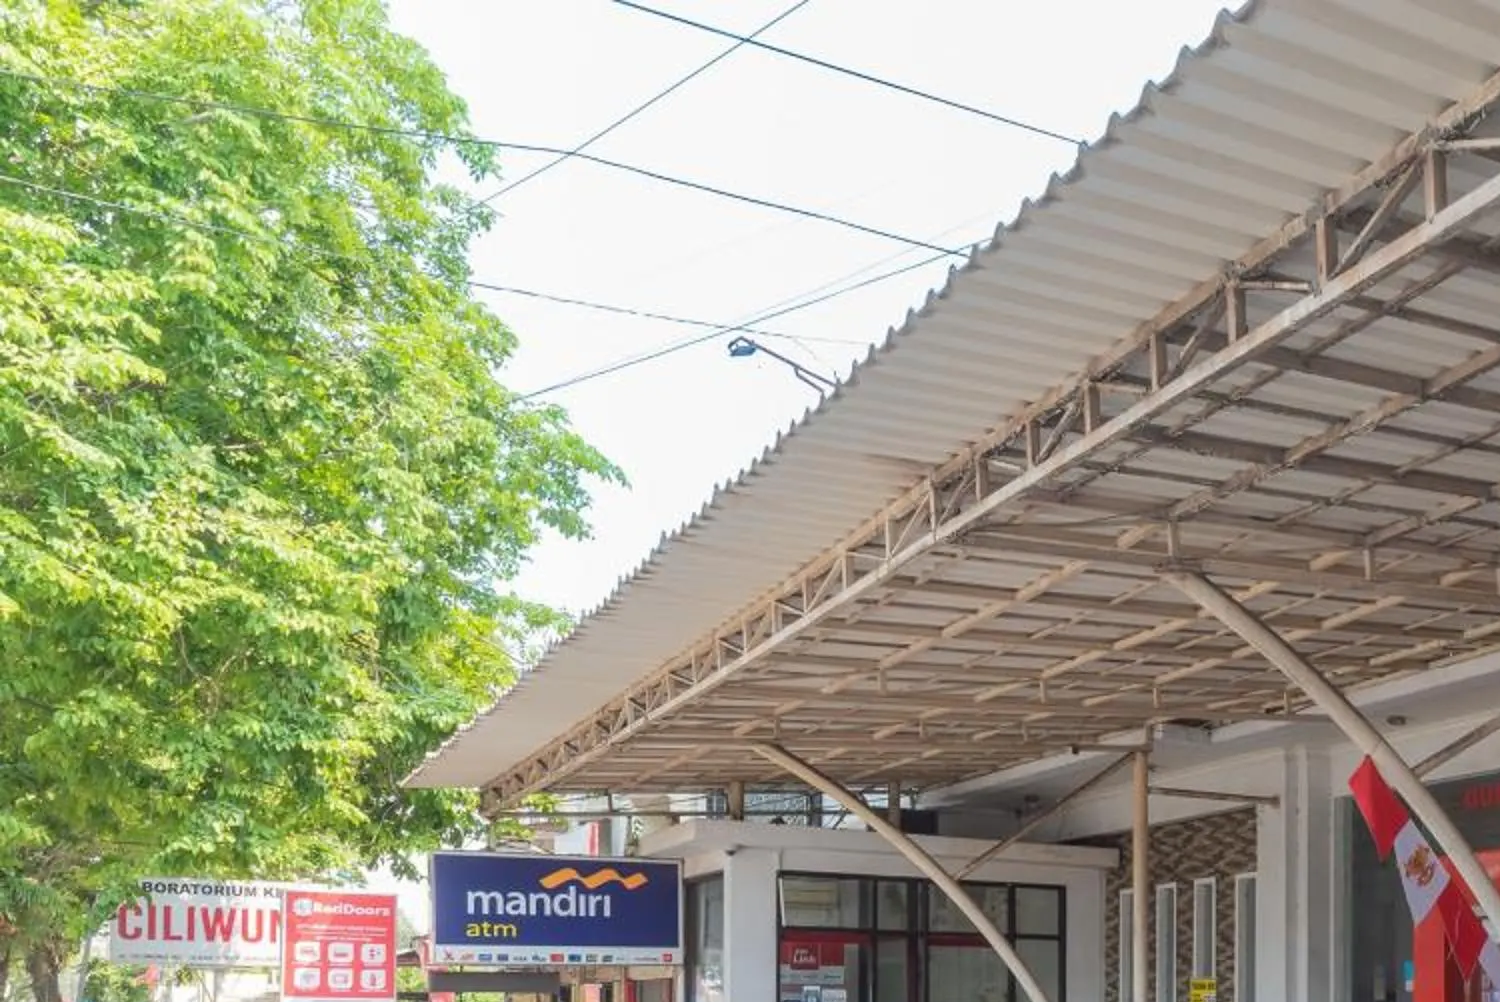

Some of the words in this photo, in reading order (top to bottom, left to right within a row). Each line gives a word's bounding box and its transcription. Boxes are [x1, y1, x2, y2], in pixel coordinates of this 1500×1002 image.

[142, 881, 258, 898] BORATORIUM
[467, 886, 612, 918] mandiri
[116, 902, 283, 944] CILIWUN
[466, 920, 517, 938] atm
